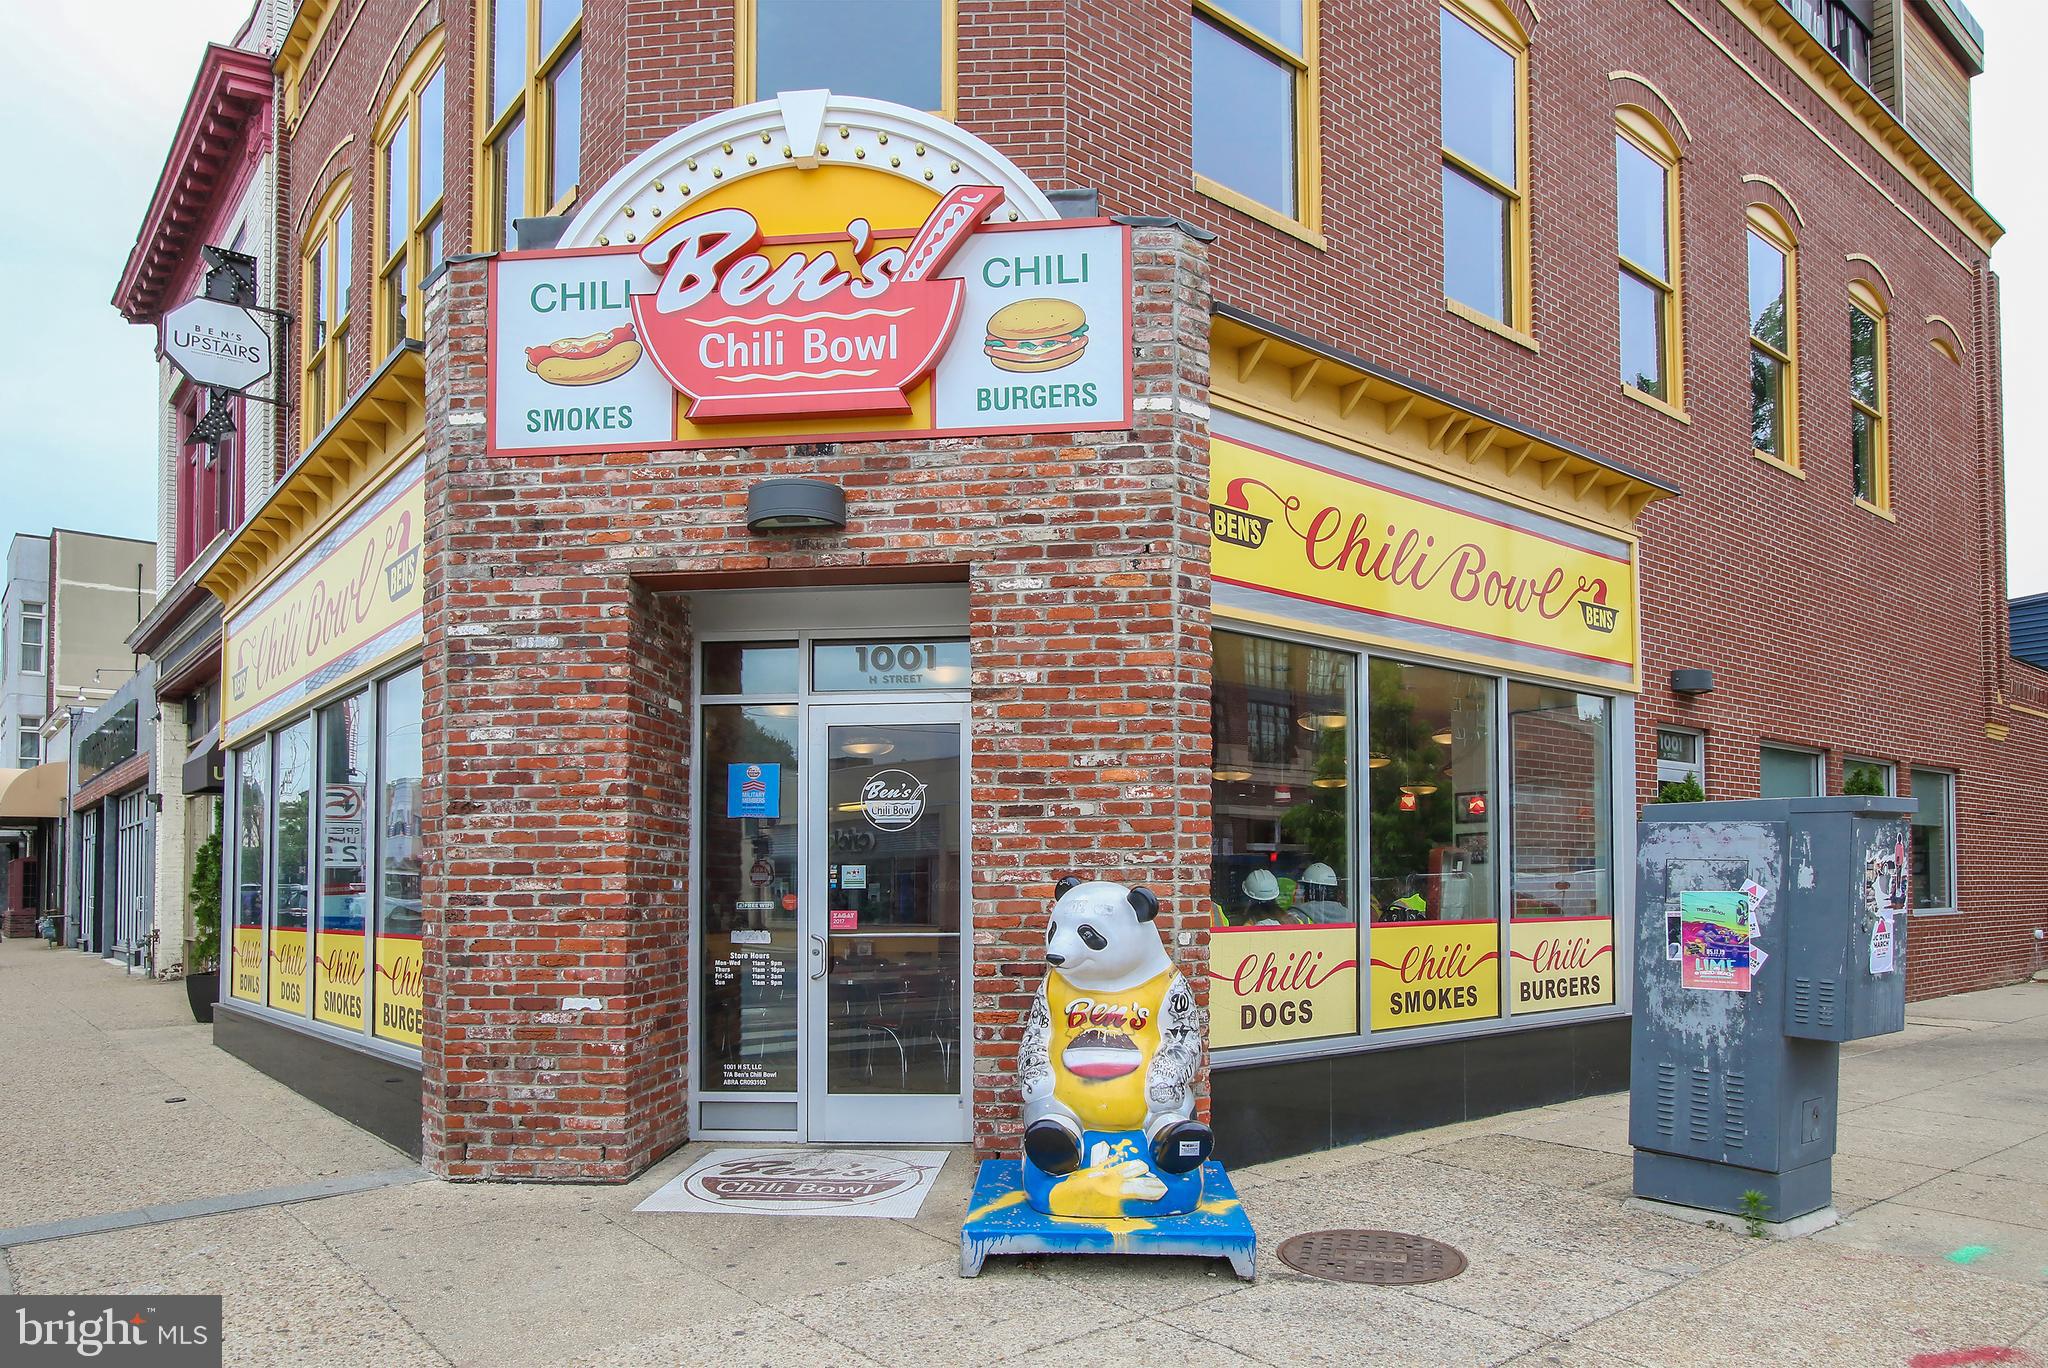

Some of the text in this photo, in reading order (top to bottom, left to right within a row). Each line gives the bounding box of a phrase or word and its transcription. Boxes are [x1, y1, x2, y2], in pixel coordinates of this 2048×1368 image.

[640, 208, 898, 313] Ben's
[982, 252, 1089, 288] CHILI
[530, 279, 631, 313] CHILI
[174, 330, 260, 364] UPSTAIRS
[195, 325, 243, 342] BEN'S
[697, 323, 898, 370] Chili Bowl
[976, 382, 1098, 413] BURGERS
[526, 405, 633, 433] SMOKES
[1213, 510, 1263, 546] BEN'S
[391, 554, 416, 597] BEN'S
[1304, 506, 1570, 620] Chili Bowl
[255, 537, 376, 691] Chili Bowl
[1585, 605, 1614, 631] BEN'S
[856, 644, 937, 673] 1001
[869, 674, 923, 685] H STREET
[1660, 734, 1682, 752] 1001
[865, 781, 912, 799] Ben's
[872, 805, 914, 815] Chili Bowl
[279, 943, 307, 976] Chili
[328, 949, 365, 986] Chili
[1400, 943, 1476, 984] Chili
[1532, 937, 1593, 974] Chili
[1695, 957, 1736, 973] LIME
[240, 973, 260, 994] BOWLS
[1233, 949, 1325, 997] Chili
[1520, 974, 1601, 1002] BURGERS
[281, 980, 300, 1003] DOGS
[324, 990, 362, 1019] SMOKES
[1390, 985, 1478, 1015] SMOKES
[1064, 997, 1150, 1030] Ben's
[1241, 999, 1313, 1030] DOGS
[719, 1160, 878, 1177] Ben's
[716, 1181, 873, 1195] Chili Bowl
